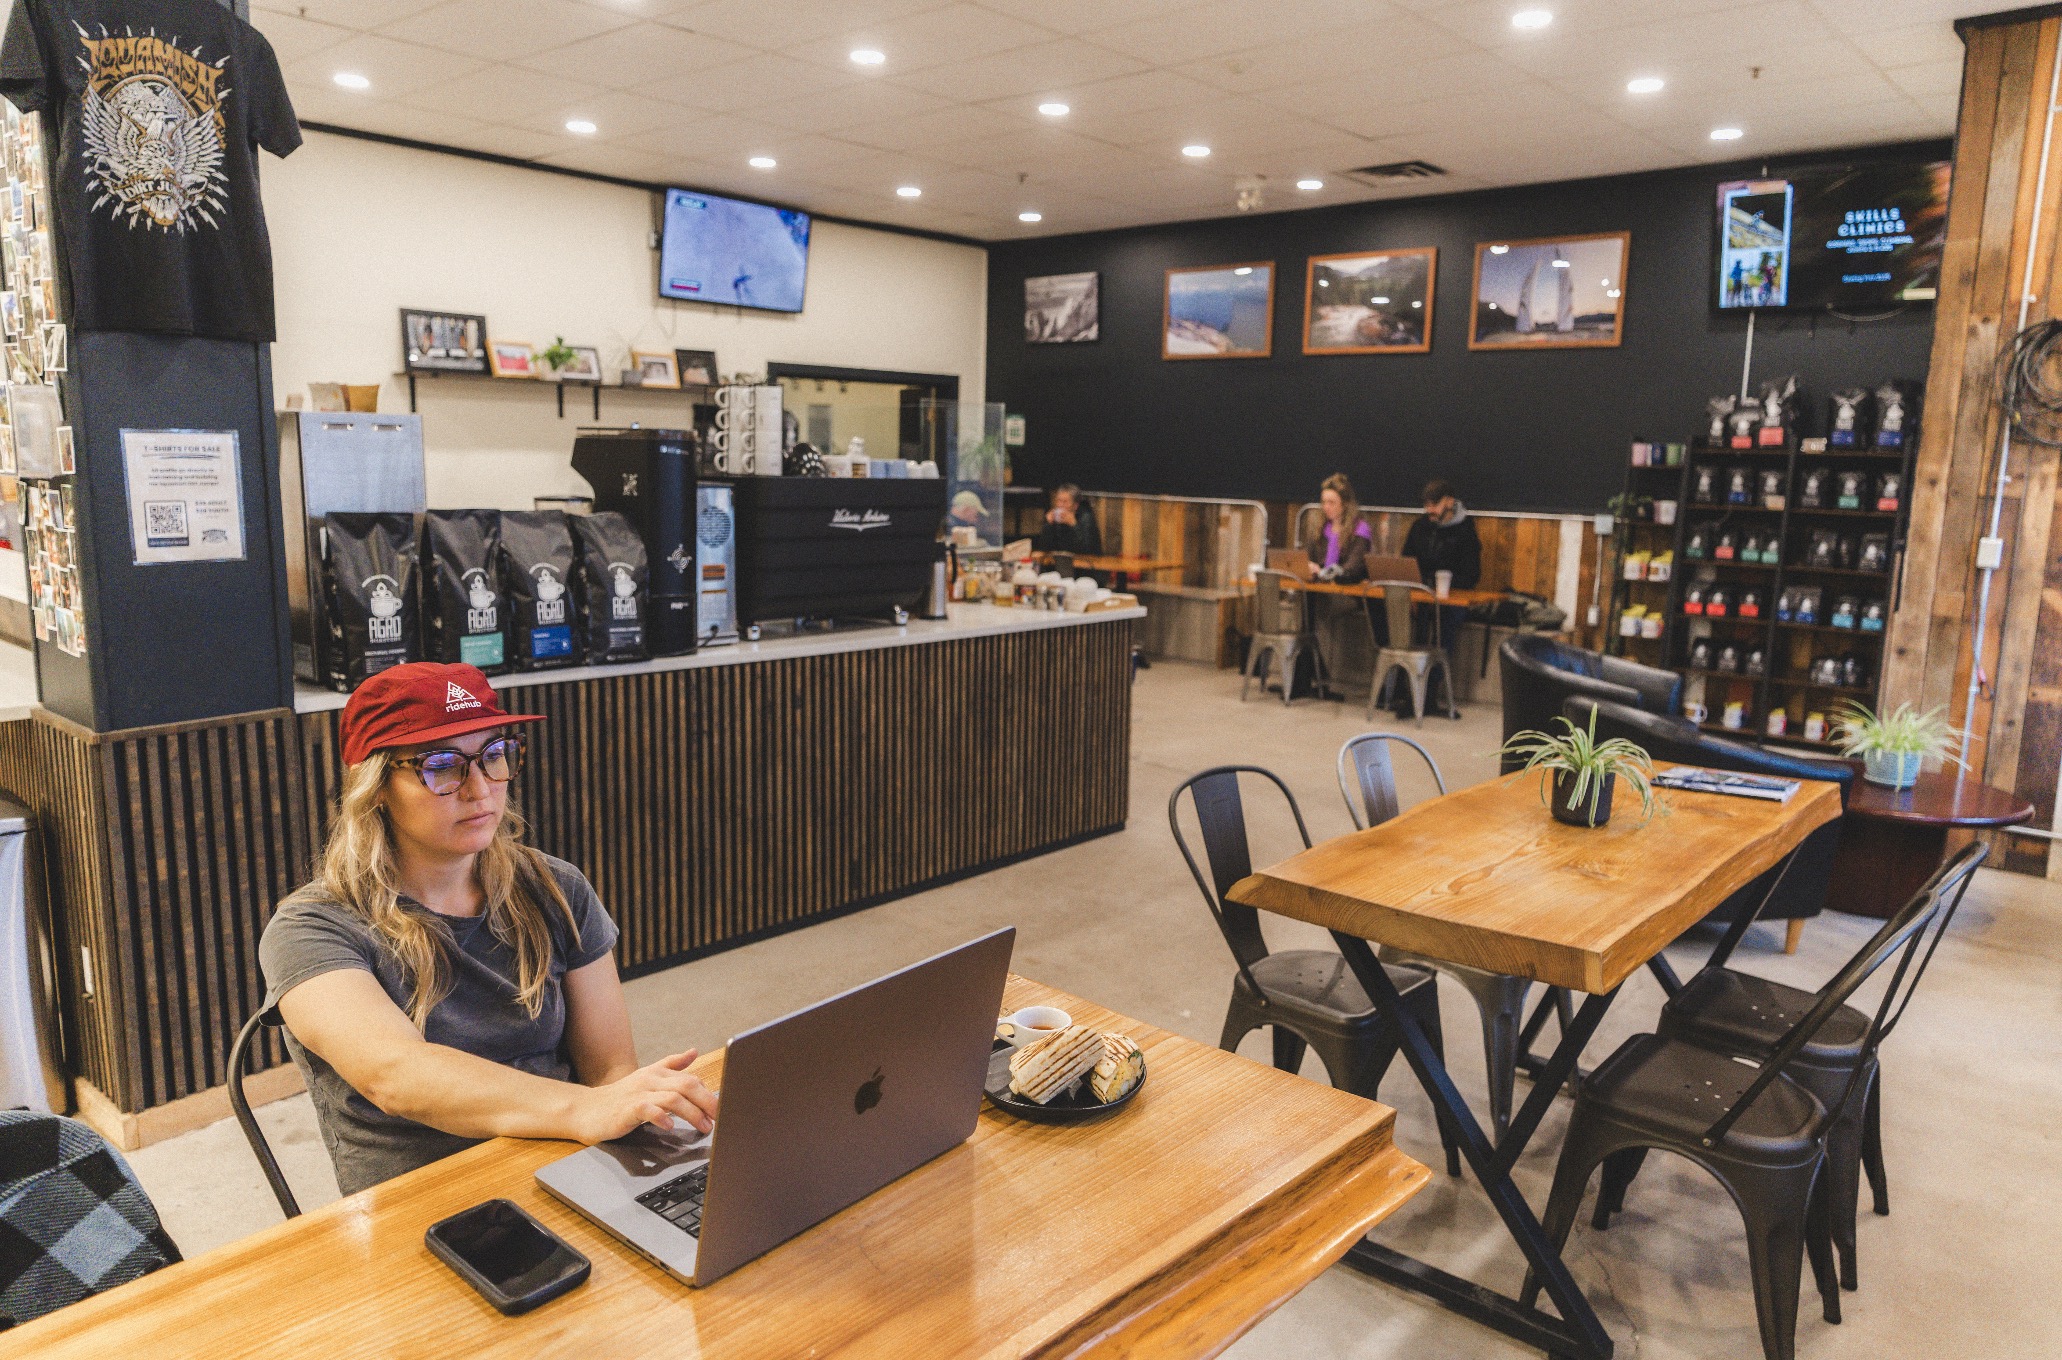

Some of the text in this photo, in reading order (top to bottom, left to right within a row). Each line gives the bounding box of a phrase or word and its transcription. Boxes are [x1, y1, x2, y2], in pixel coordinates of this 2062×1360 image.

[124, 180, 154, 198] DIRT
[1845, 207, 1900, 224] SKILLS
[1838, 219, 1906, 237] CLINICS
[468, 607, 497, 630] AGRO
[368, 616, 402, 640] AGRO
[445, 700, 482, 712] ridehub
